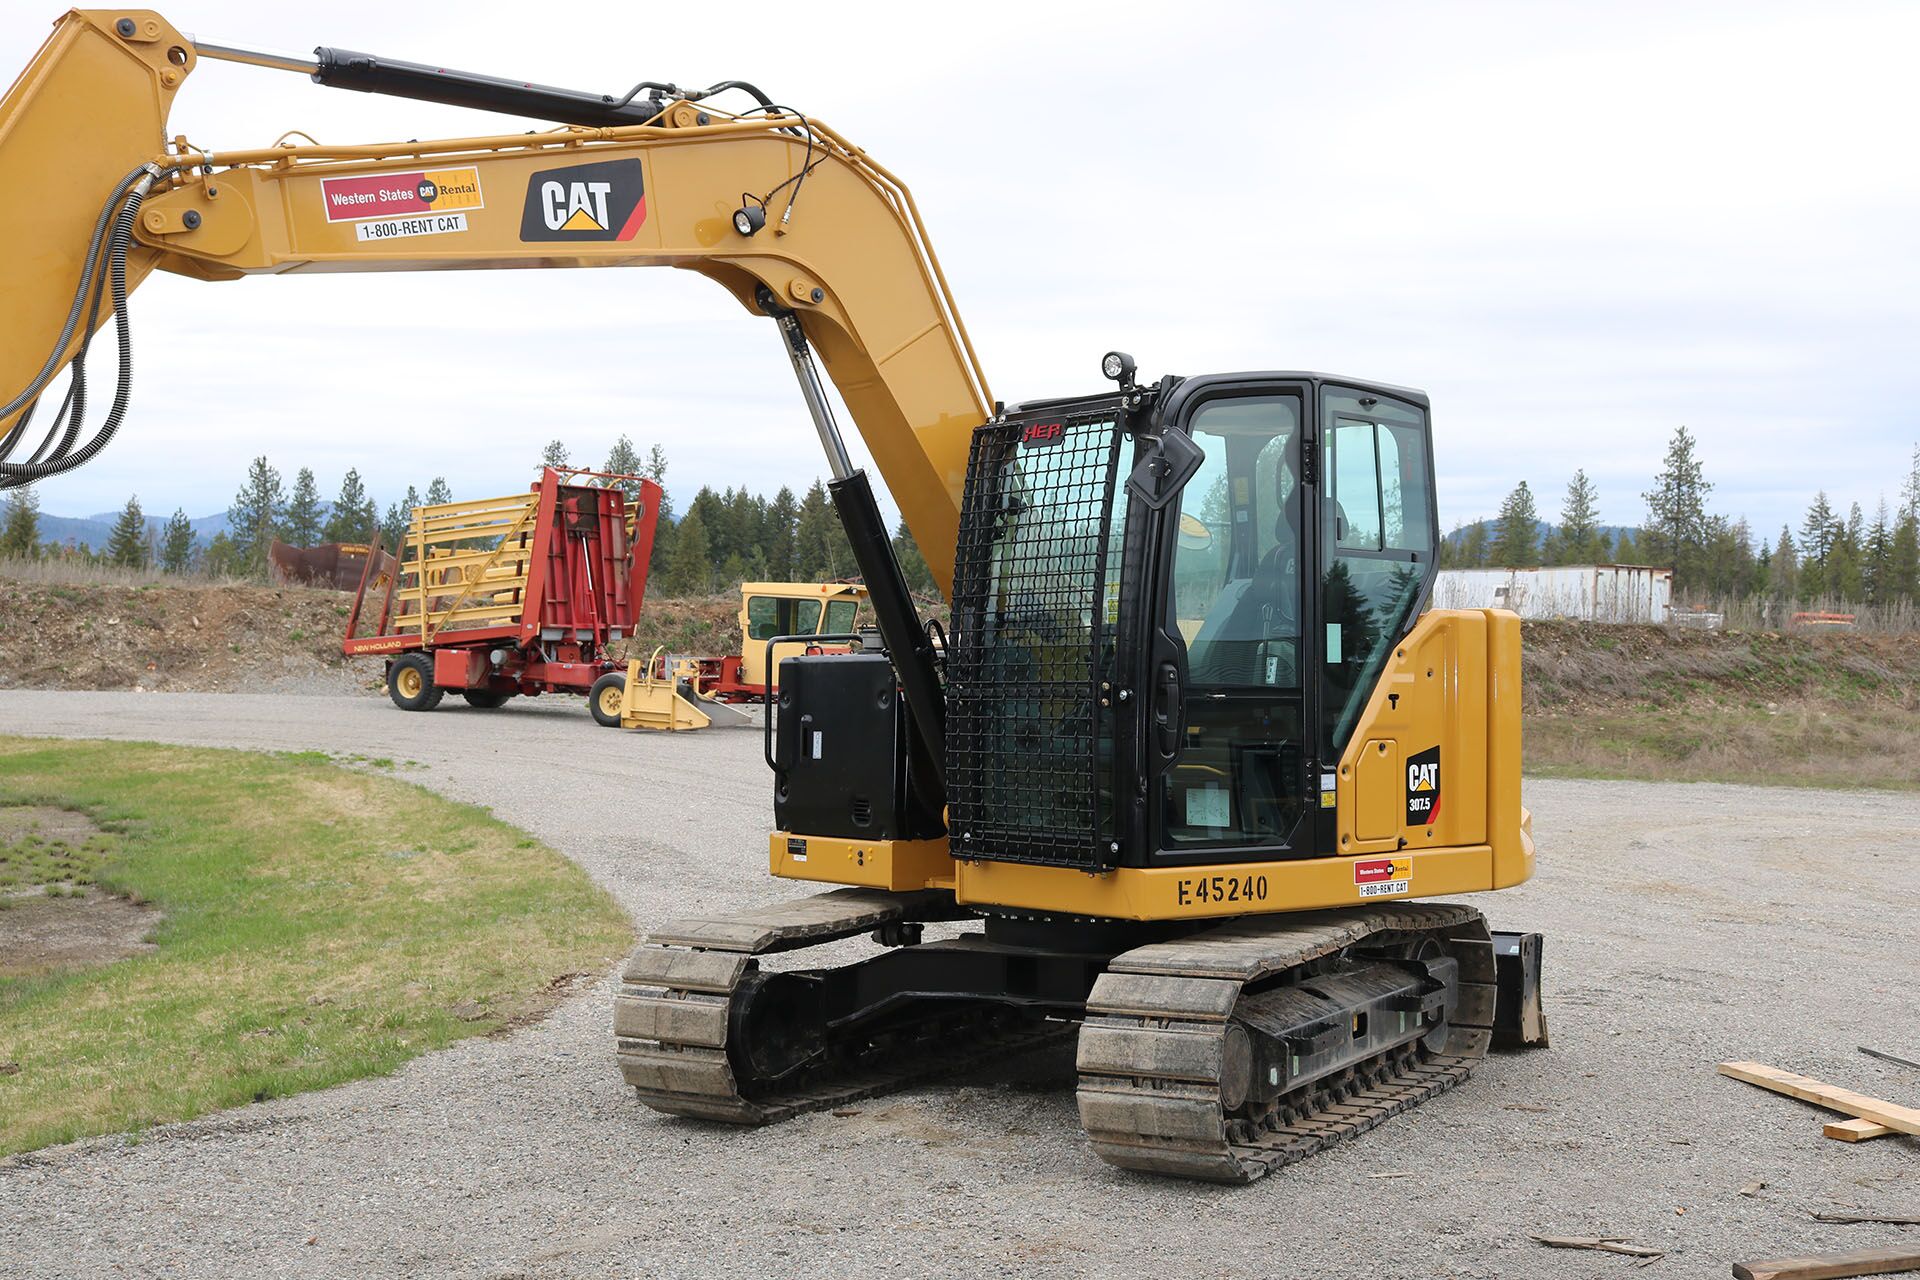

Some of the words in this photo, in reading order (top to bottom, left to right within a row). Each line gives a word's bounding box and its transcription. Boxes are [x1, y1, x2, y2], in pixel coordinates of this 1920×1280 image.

[331, 191, 376, 206] Western
[380, 188, 414, 202] States
[419, 186, 435, 197] CAT
[439, 183, 476, 195] Rental
[541, 181, 611, 231] CAT
[363, 219, 433, 239] 1-800-RENT
[438, 216, 460, 231] CAT
[370, 641, 401, 651] HOLLAND
[1409, 763, 1438, 792] CAT
[1409, 797, 1431, 812] 307.5
[1178, 875, 1268, 906] E45240
[1361, 883, 1394, 895] 1-800-RENT
[1396, 882, 1407, 892] CAT
